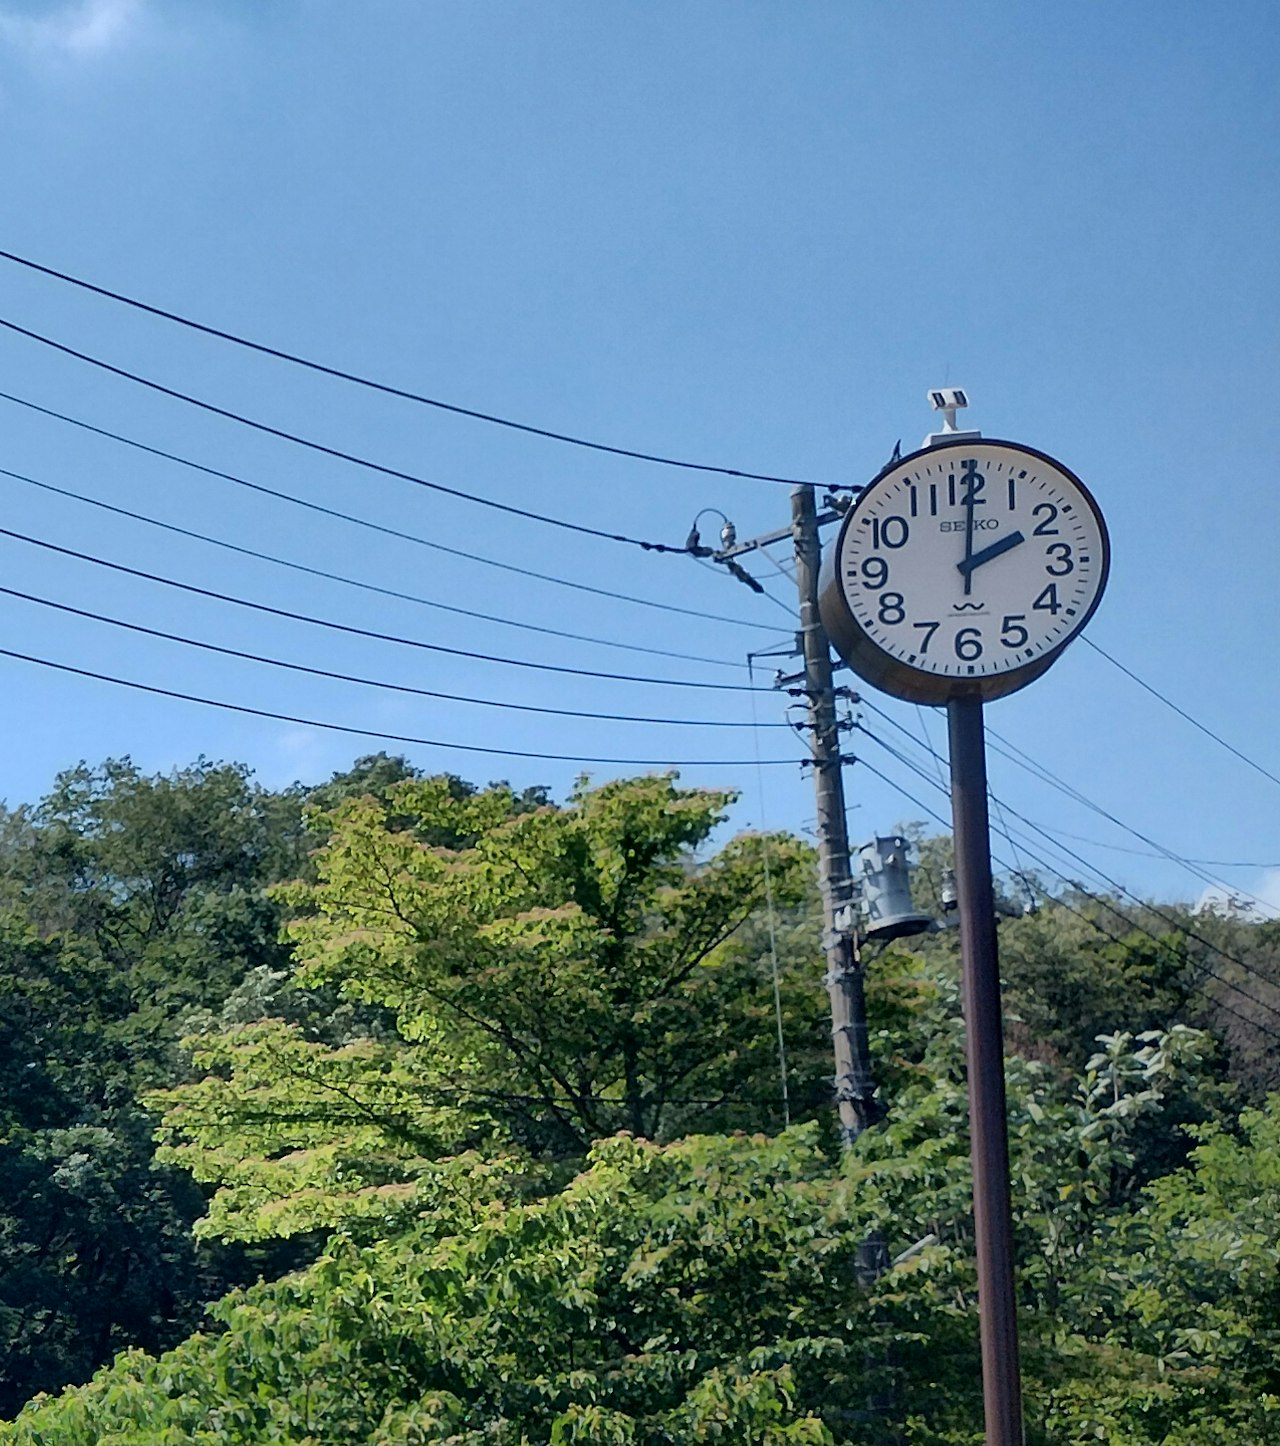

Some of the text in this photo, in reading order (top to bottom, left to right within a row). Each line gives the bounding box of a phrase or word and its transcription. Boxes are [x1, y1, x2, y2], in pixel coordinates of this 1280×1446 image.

[910, 485, 937, 517] 11
[948, 472, 987, 506] 12
[1008, 478, 1016, 511] 1
[871, 515, 909, 550] 10
[939, 519, 999, 533] SEKO
[1032, 503, 1059, 536] 2
[861, 557, 889, 590] 9
[1045, 542, 1074, 576] 3
[878, 592, 906, 625] 8
[1032, 583, 1062, 616] 4
[912, 622, 941, 654] 7
[954, 628, 983, 662] 6
[1000, 615, 1029, 648] 5
